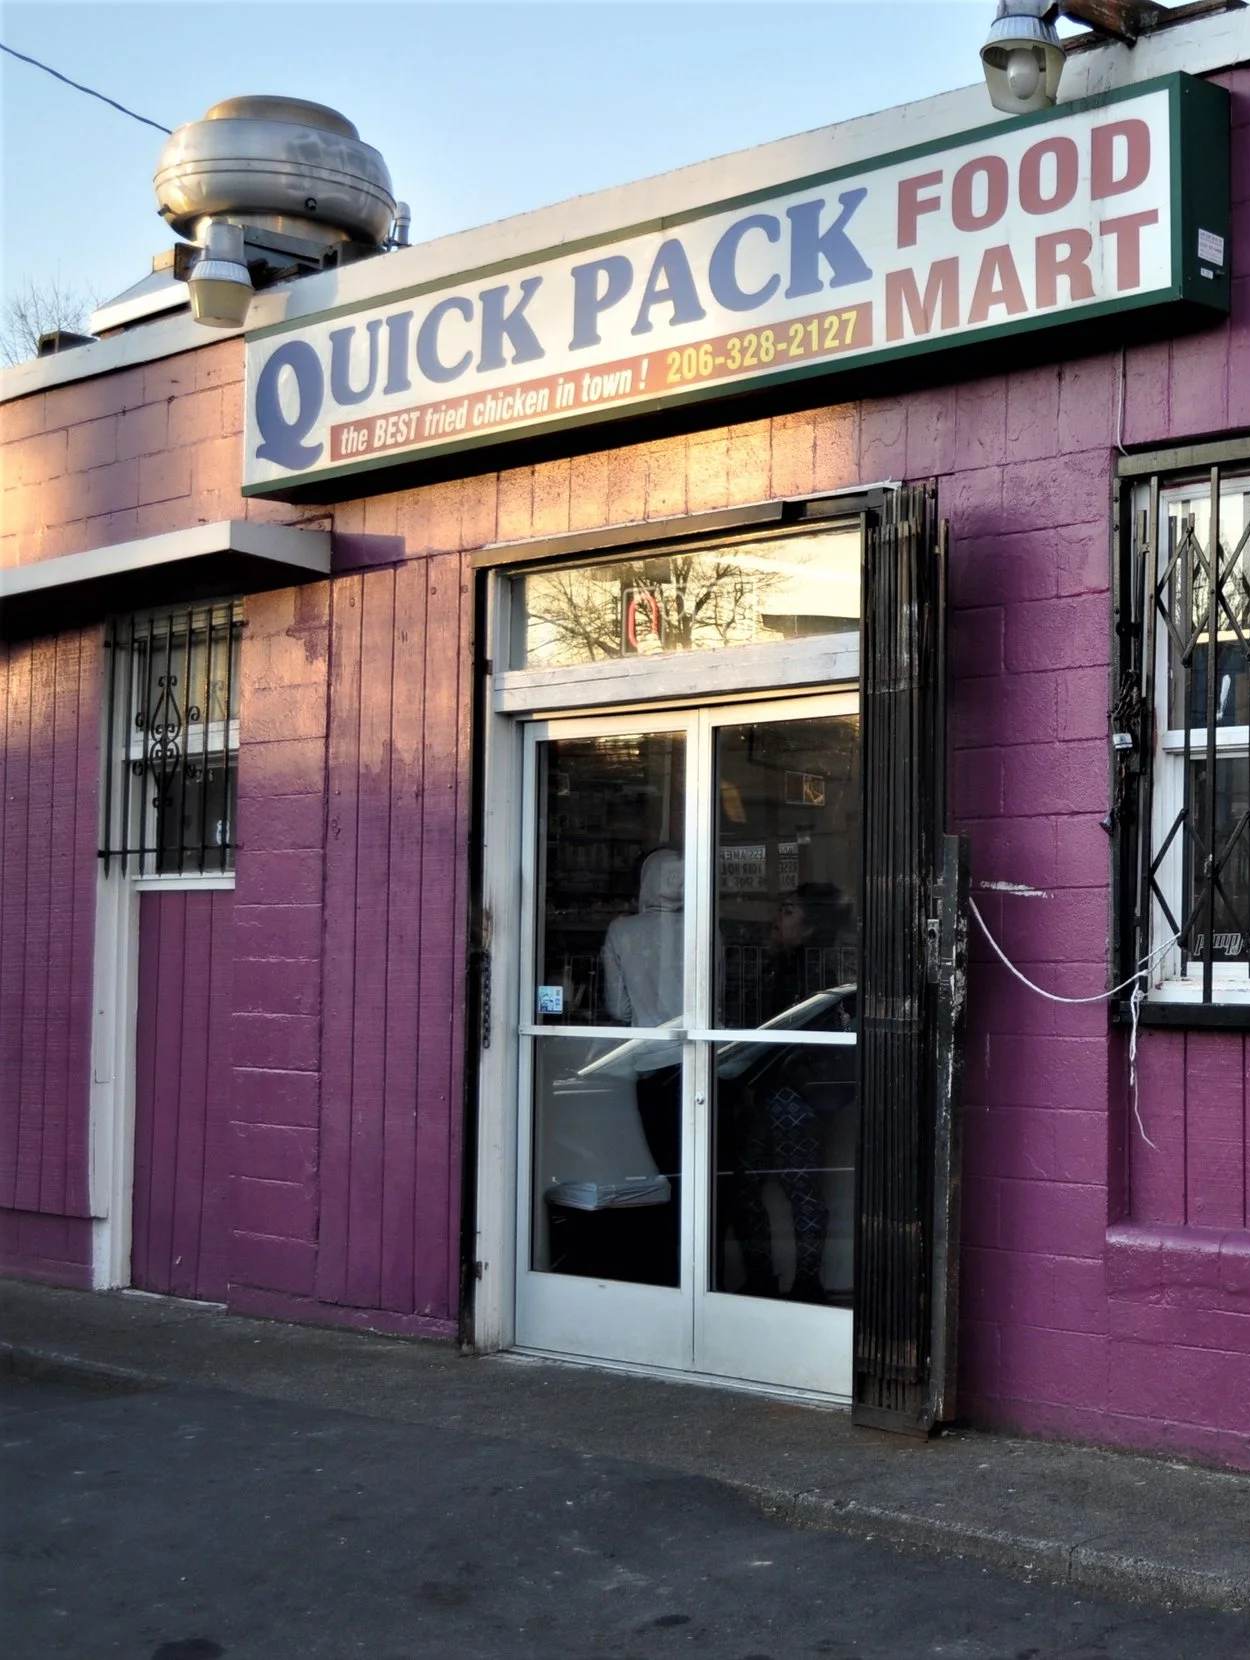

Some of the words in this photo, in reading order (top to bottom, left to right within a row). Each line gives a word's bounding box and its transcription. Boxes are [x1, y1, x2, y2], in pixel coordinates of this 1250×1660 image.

[897, 118, 1151, 249] FOOD
[256, 275, 545, 470] QUICK
[568, 187, 873, 352] PACK
[885, 209, 1159, 342] MART
[340, 425, 368, 455] the
[373, 411, 420, 448] BEST
[424, 400, 468, 437] fried
[473, 386, 551, 425] chicken
[555, 376, 575, 409] in
[582, 368, 633, 403] town
[666, 310, 858, 384] 206-328-2127
